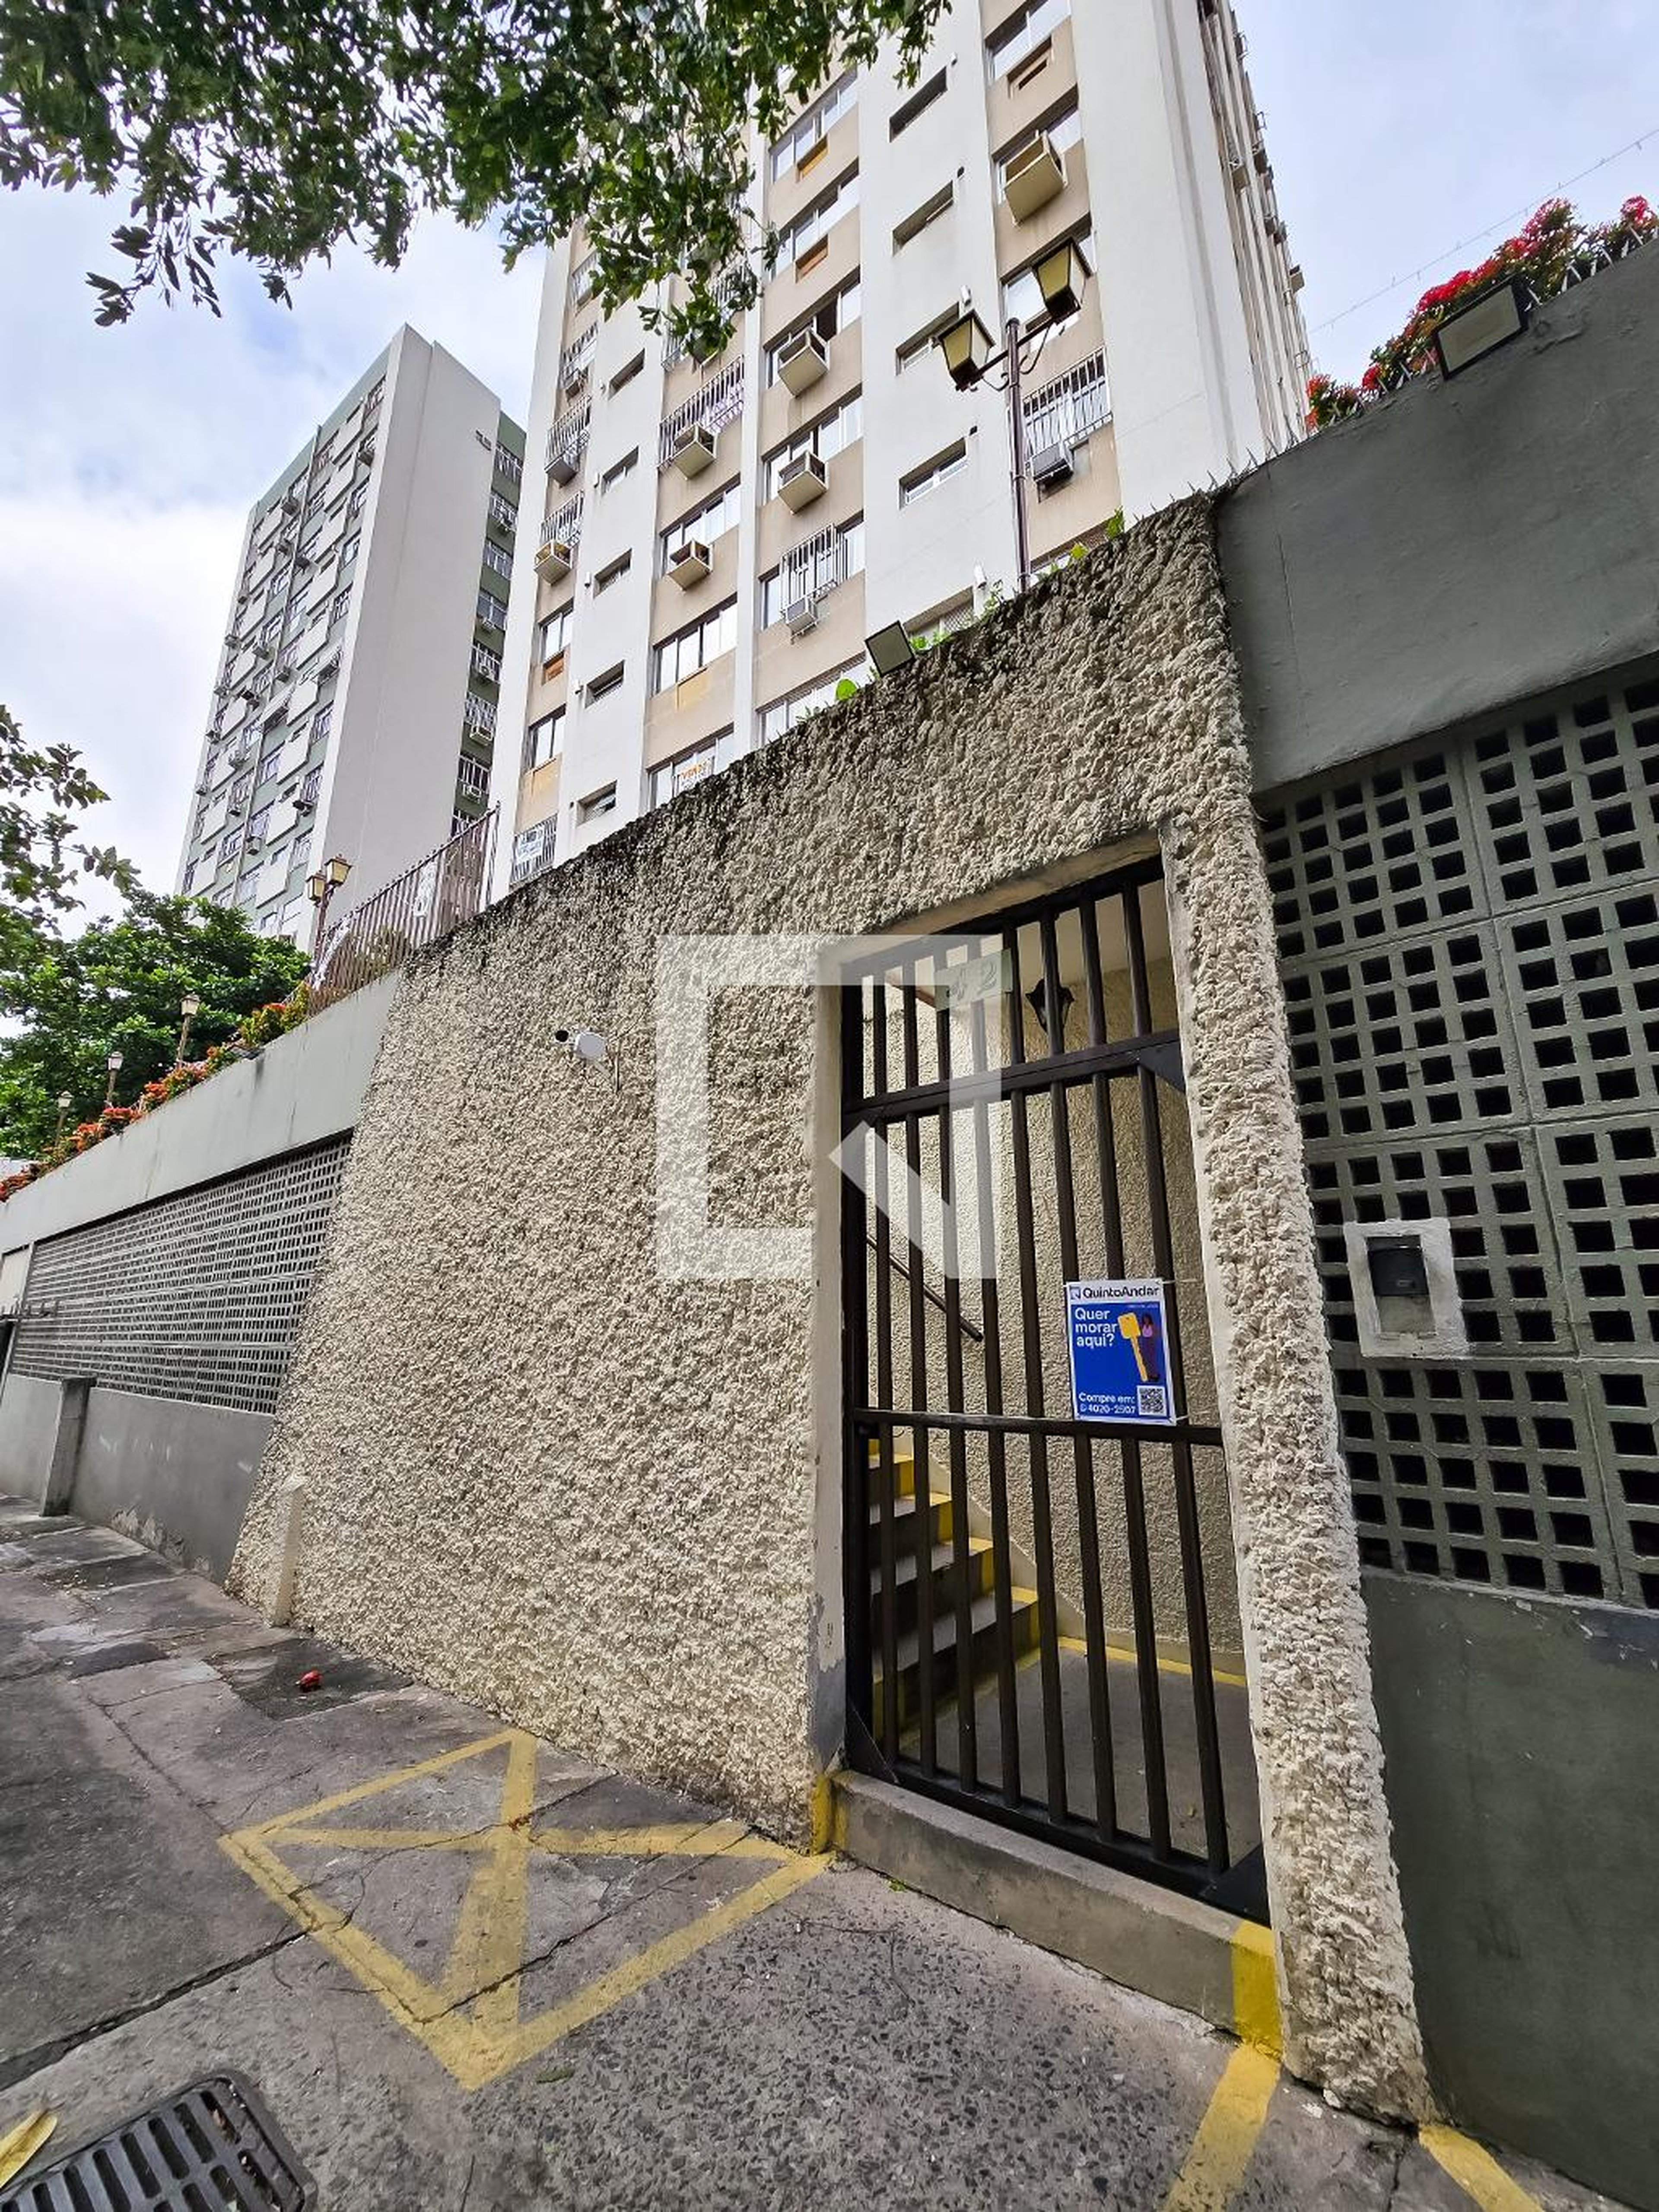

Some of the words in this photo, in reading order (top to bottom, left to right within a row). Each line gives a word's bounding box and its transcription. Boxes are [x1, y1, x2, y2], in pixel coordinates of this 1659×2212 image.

[1083, 1286, 1159, 1298] QuintoAndar
[1074, 1307, 1110, 1321] Quer
[1075, 1323, 1118, 1333] morar
[1076, 1334, 1115, 1349] aqui?
[1078, 1392, 1116, 1403] Compre
